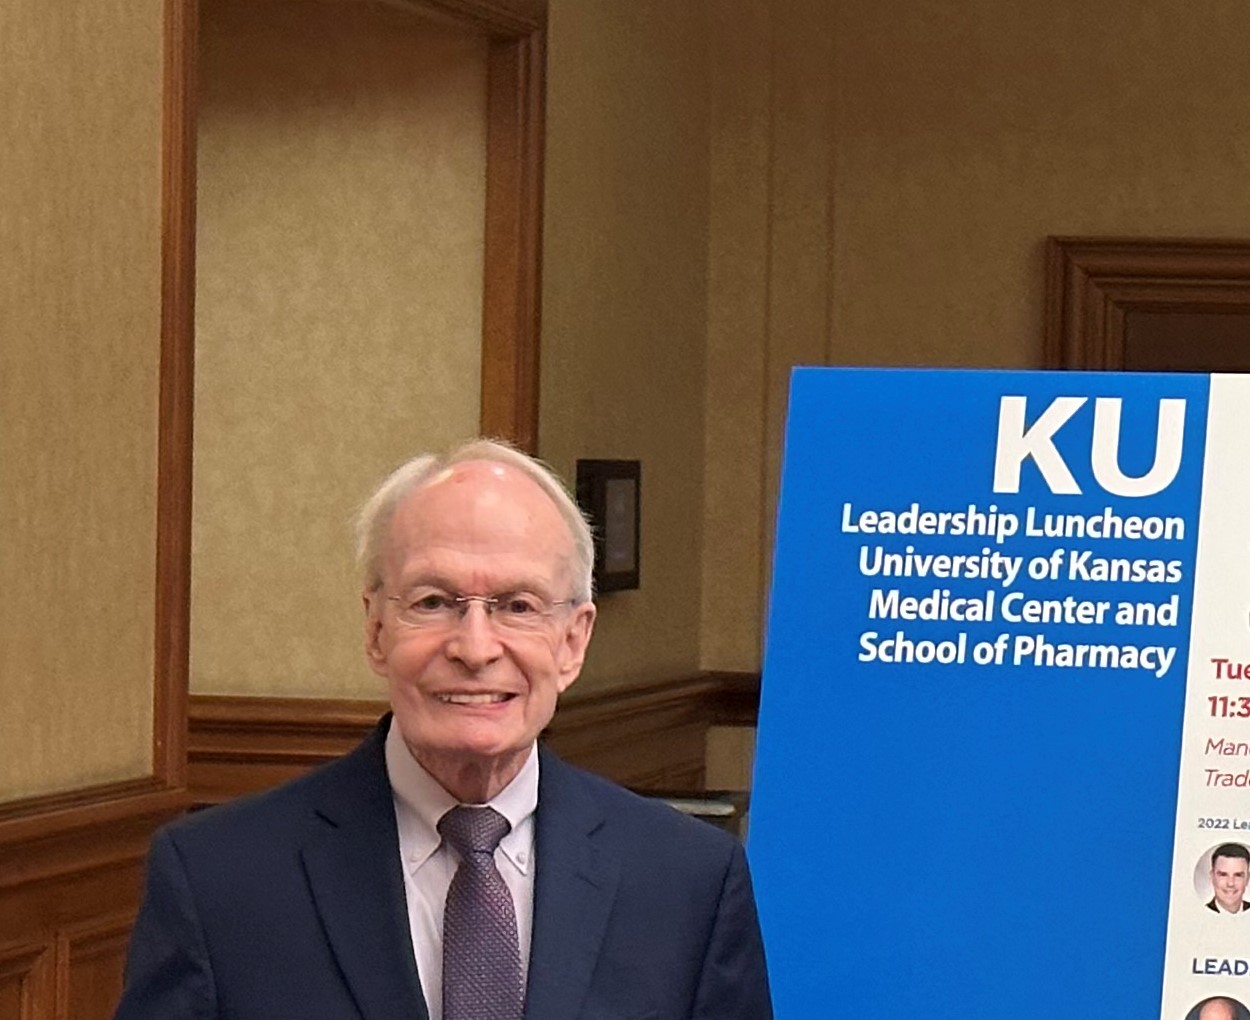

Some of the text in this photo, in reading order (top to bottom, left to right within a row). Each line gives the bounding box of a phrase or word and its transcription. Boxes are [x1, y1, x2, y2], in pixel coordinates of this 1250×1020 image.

[993, 396, 1186, 497] KU
[842, 503, 1184, 543] Leadership Luncheon
[860, 546, 1181, 587] University of Kansas
[869, 589, 1179, 626] Medical Center and
[859, 632, 1176, 677] School of Pharmacy
[1197, 818, 1230, 829] 2022
